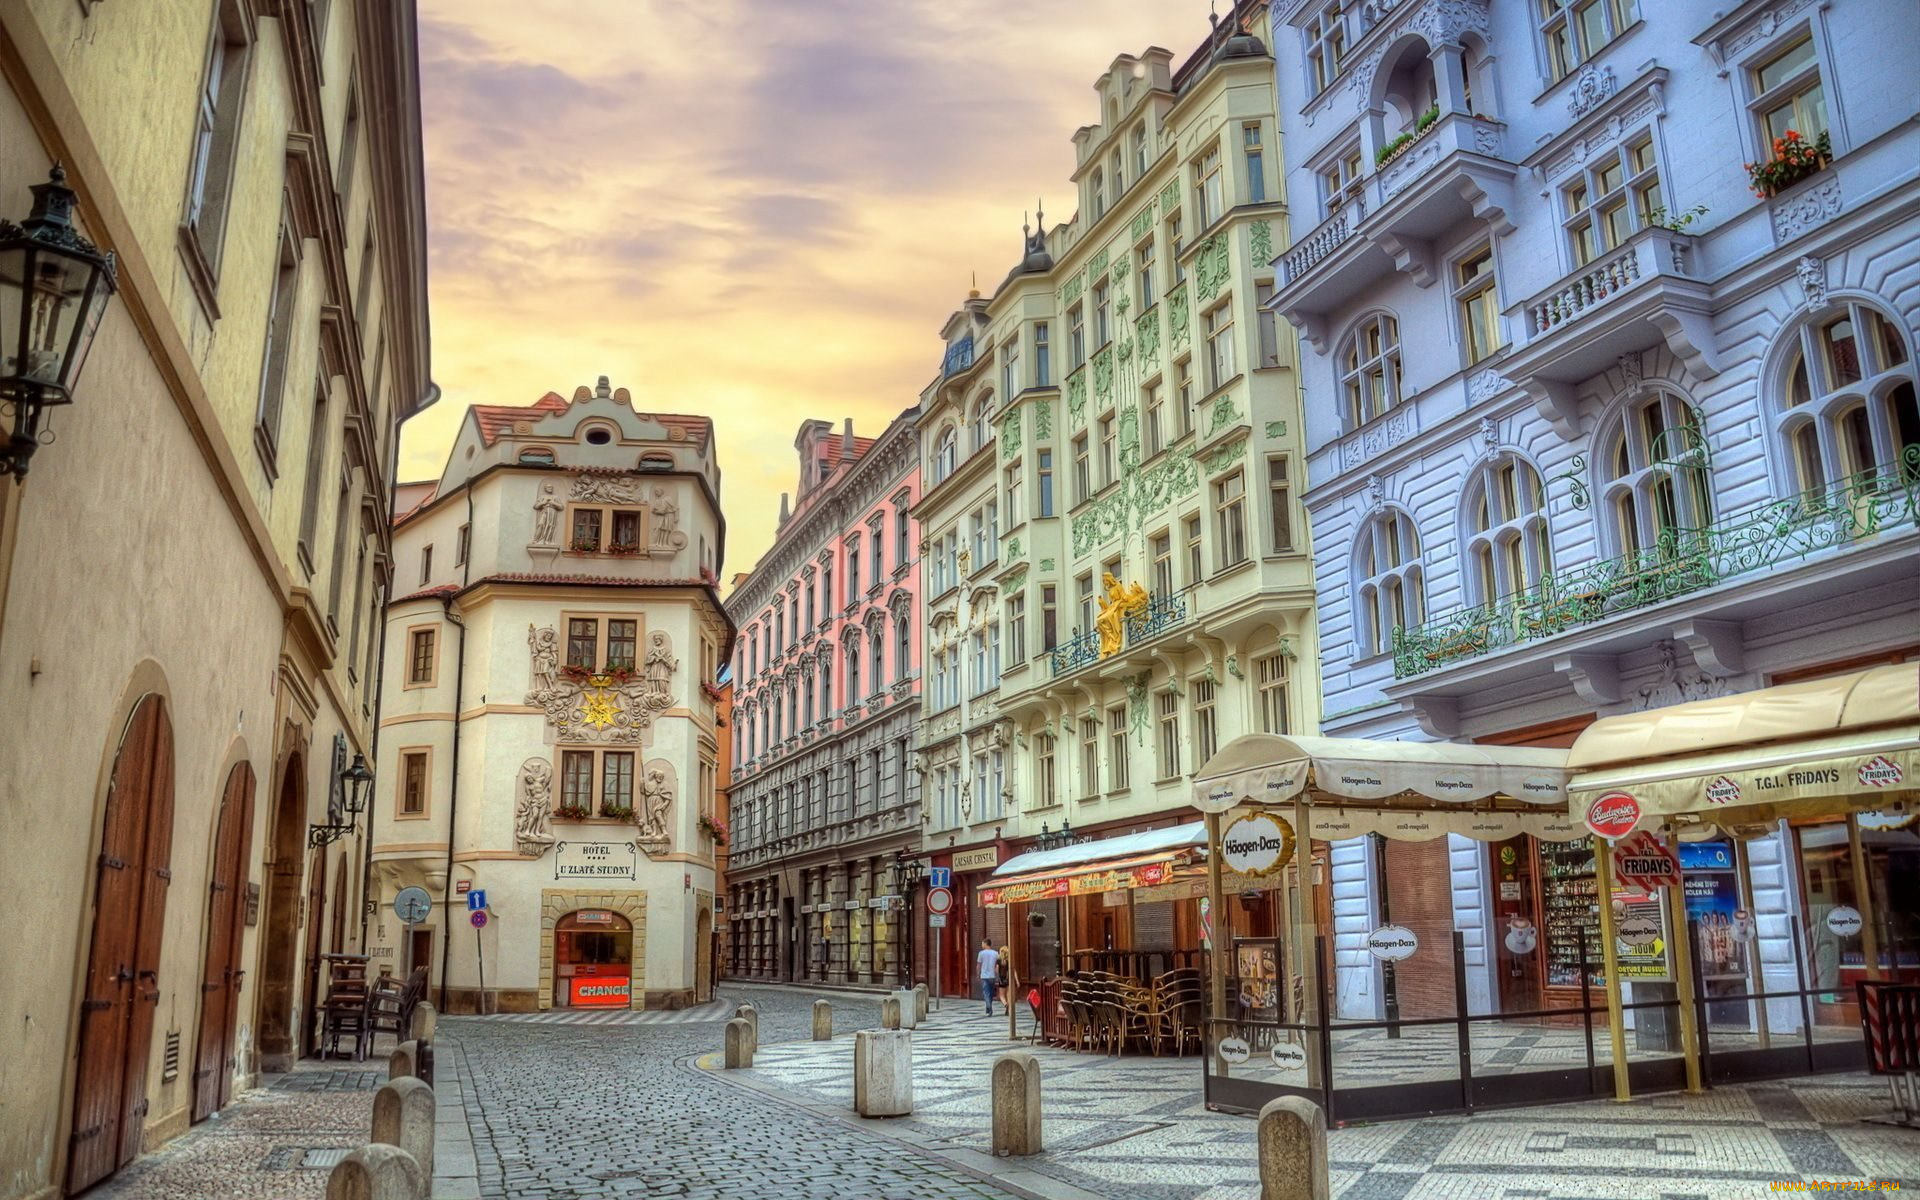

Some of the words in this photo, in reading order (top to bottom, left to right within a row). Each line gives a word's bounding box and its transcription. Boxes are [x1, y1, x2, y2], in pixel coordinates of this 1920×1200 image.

[1341, 776, 1381, 786] Häagen-Dazs
[1435, 780, 1473, 789] Häagen-Dazs
[1755, 776, 1783, 790] T.G.I.
[583, 846, 610, 855] HOTEL
[1225, 836, 1280, 857] Häagen-Dazs
[954, 855, 973, 867] CAESAR
[974, 852, 995, 865] CRYSTAL
[560, 866, 566, 874] U
[569, 864, 595, 875] ZLATÉ
[597, 866, 631, 875] STUDNY
[1370, 939, 1416, 950] Häagen-Dazs
[579, 985, 630, 997] CHANGE
